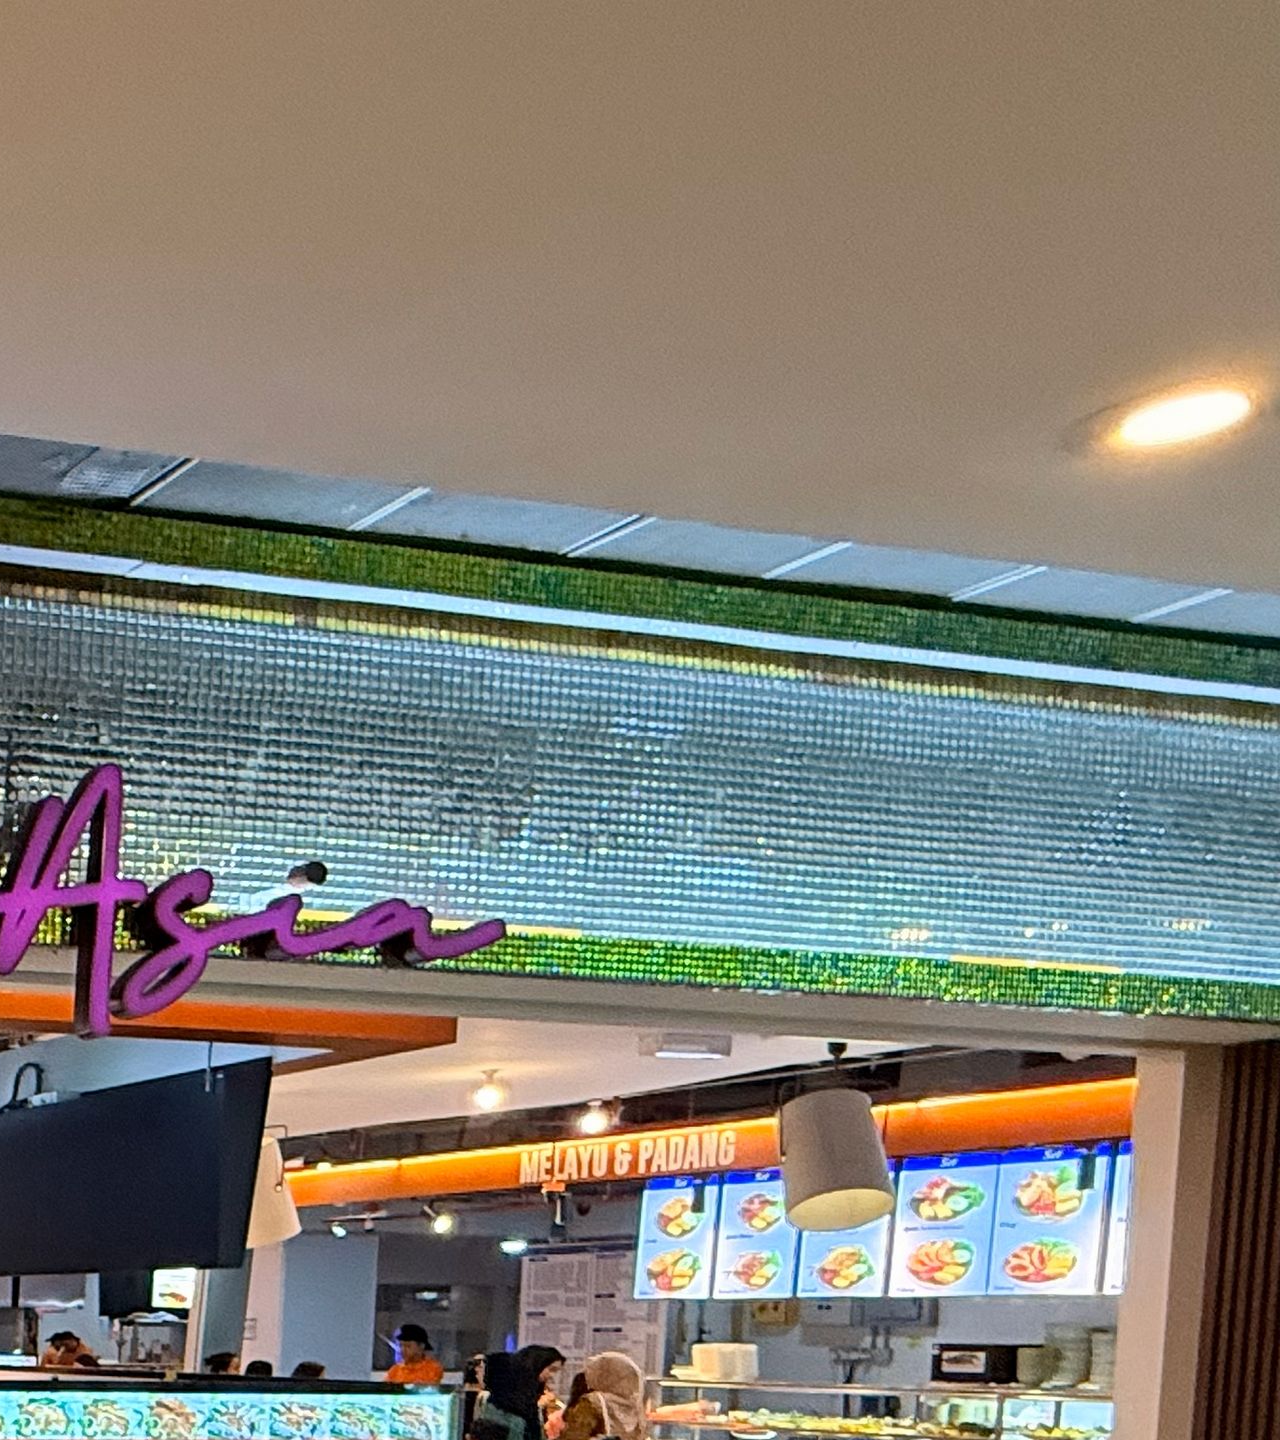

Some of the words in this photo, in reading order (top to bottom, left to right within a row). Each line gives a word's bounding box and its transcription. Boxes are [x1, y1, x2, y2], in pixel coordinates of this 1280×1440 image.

[519, 1143, 608, 1185] MELAYU
[613, 1141, 632, 1176] &
[637, 1130, 738, 1174] PADANG
